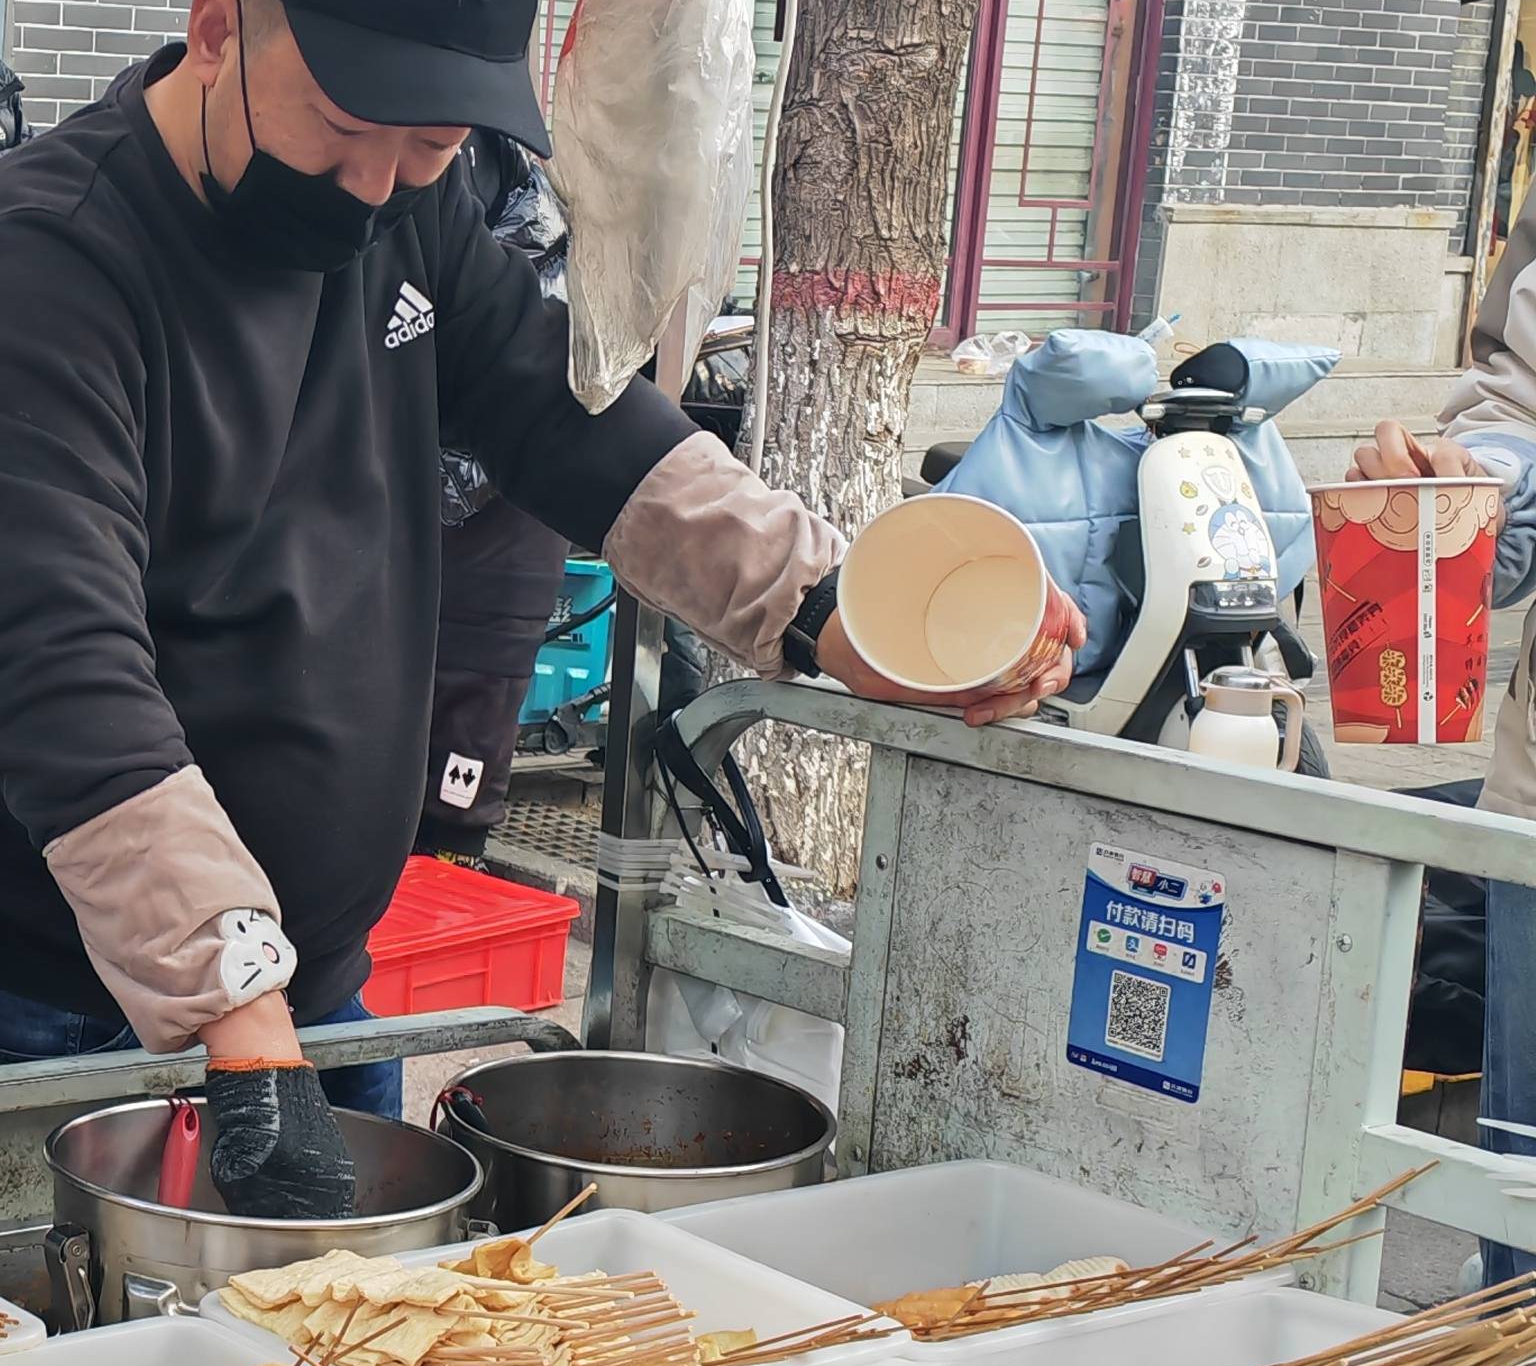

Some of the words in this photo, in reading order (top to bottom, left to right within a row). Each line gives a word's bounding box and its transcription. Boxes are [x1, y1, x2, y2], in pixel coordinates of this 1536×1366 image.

[1106, 900, 1194, 943] 付款请扫码
